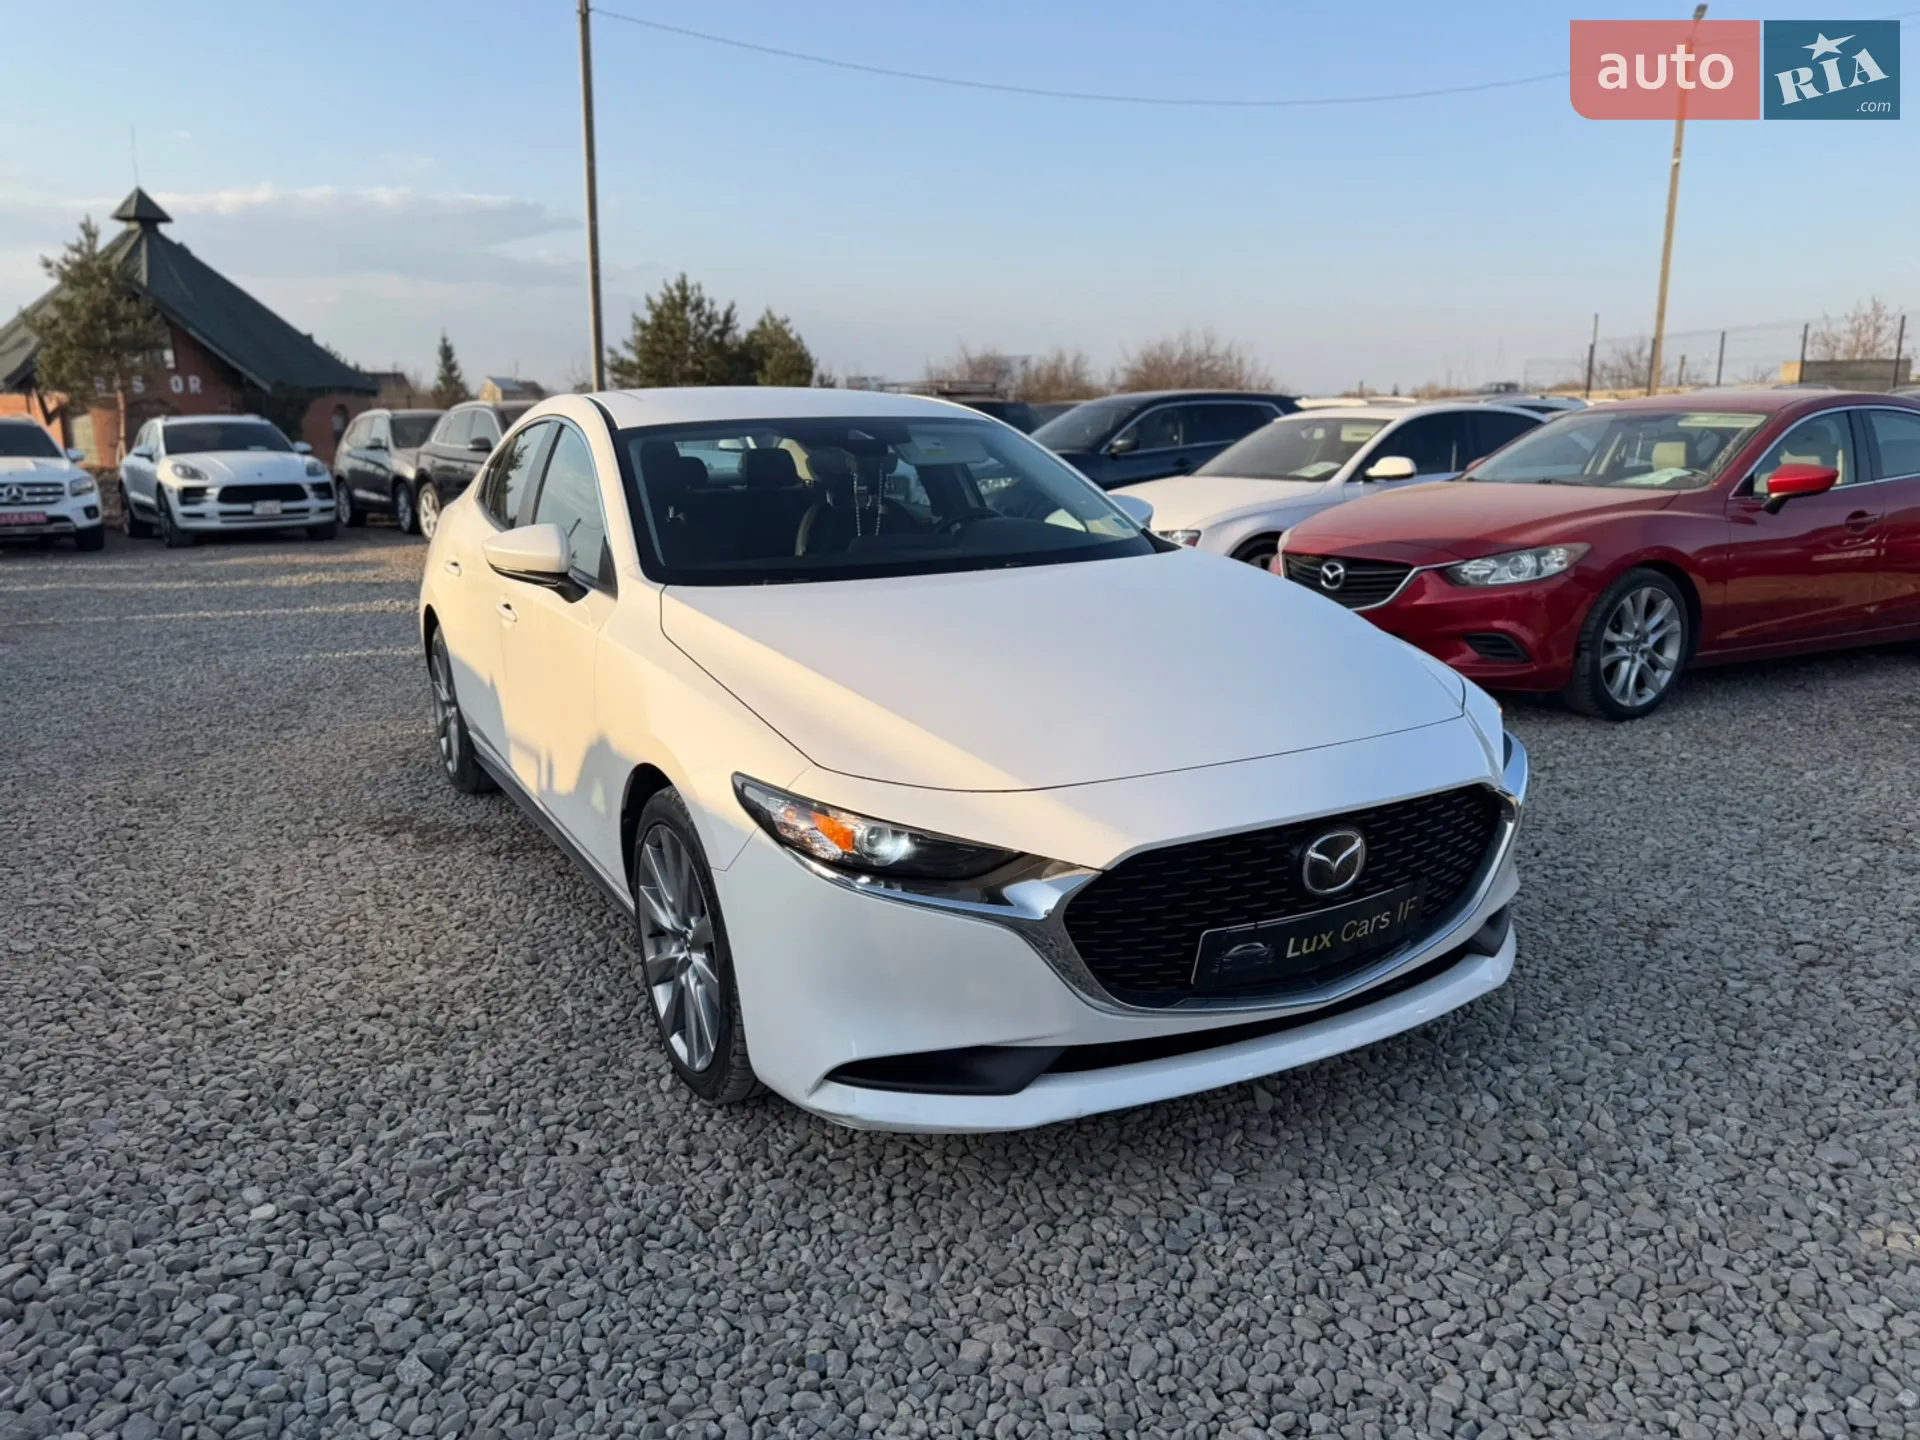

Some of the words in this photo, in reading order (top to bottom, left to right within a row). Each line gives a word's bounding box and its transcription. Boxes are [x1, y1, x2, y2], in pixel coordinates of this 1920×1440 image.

[1286, 930, 1334, 959] Lux
[1341, 911, 1391, 942] Cars
[1397, 896, 1418, 922] IF
